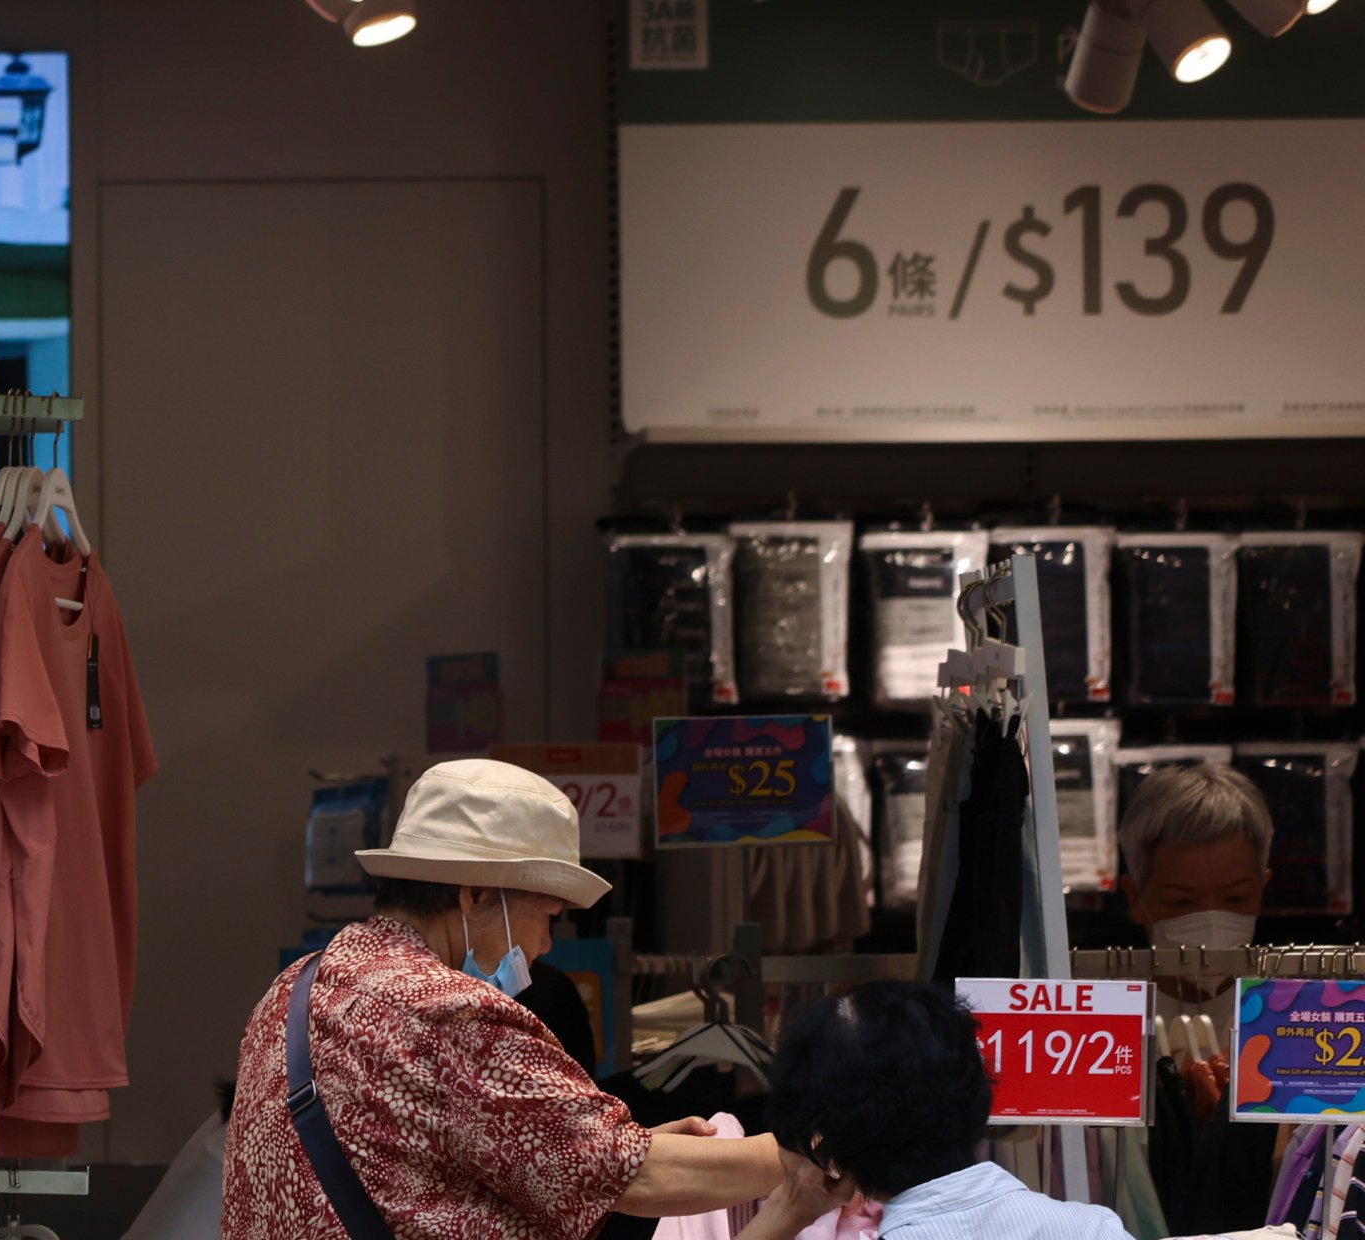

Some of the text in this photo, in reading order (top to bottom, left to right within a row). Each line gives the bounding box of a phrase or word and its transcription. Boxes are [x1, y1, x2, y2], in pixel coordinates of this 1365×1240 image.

[728, 759, 797, 797] $25
[1009, 984, 1094, 1012] SALE
[1315, 1026, 1365, 1067] $2
[1114, 1065, 1133, 1075] PCS
